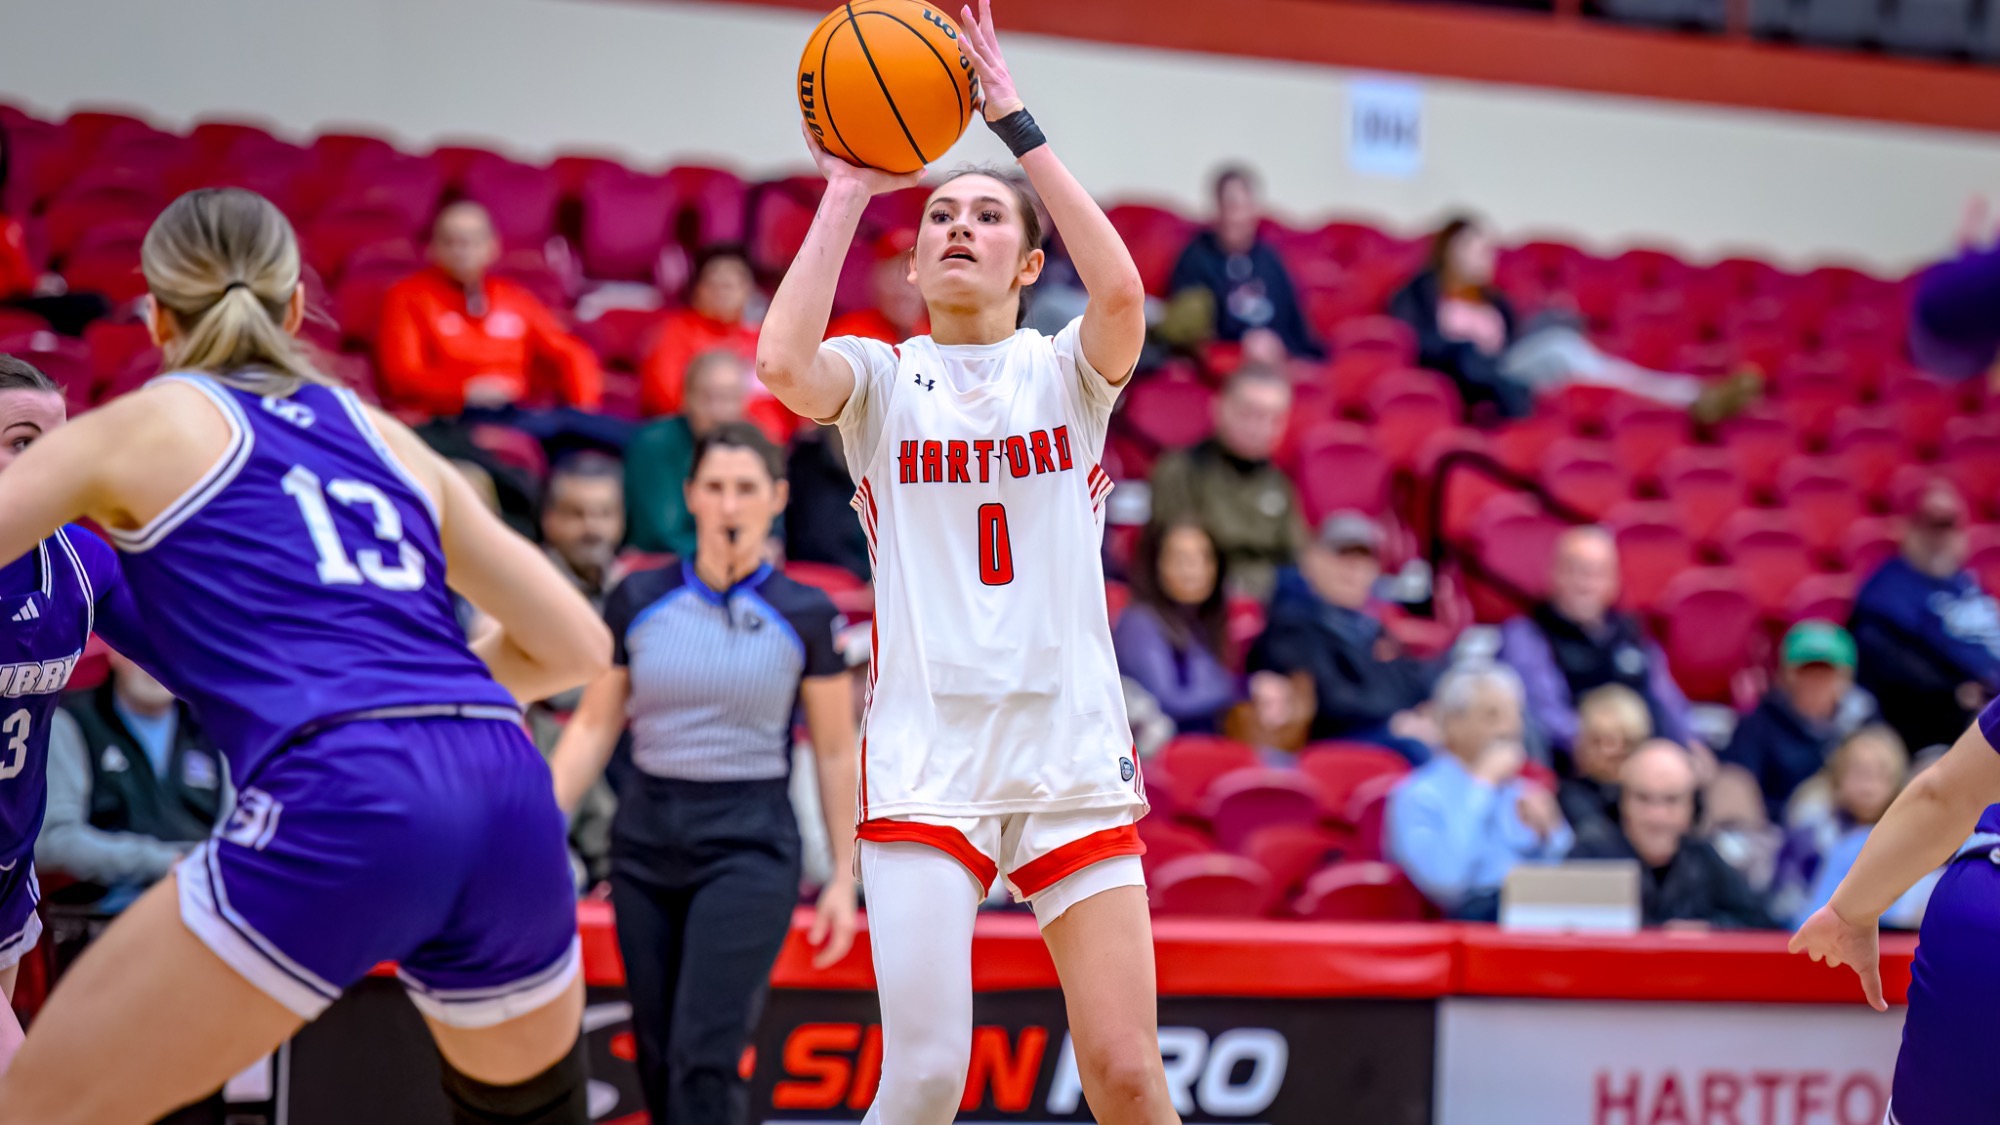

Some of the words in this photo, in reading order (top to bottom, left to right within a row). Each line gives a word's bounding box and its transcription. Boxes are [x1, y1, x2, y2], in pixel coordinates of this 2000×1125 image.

[897, 425, 1073, 483] HARTORD
[280, 463, 426, 591] 13
[978, 502, 1014, 586] 0
[0, 708, 31, 780] 3
[772, 1022, 1048, 1112] SIN
